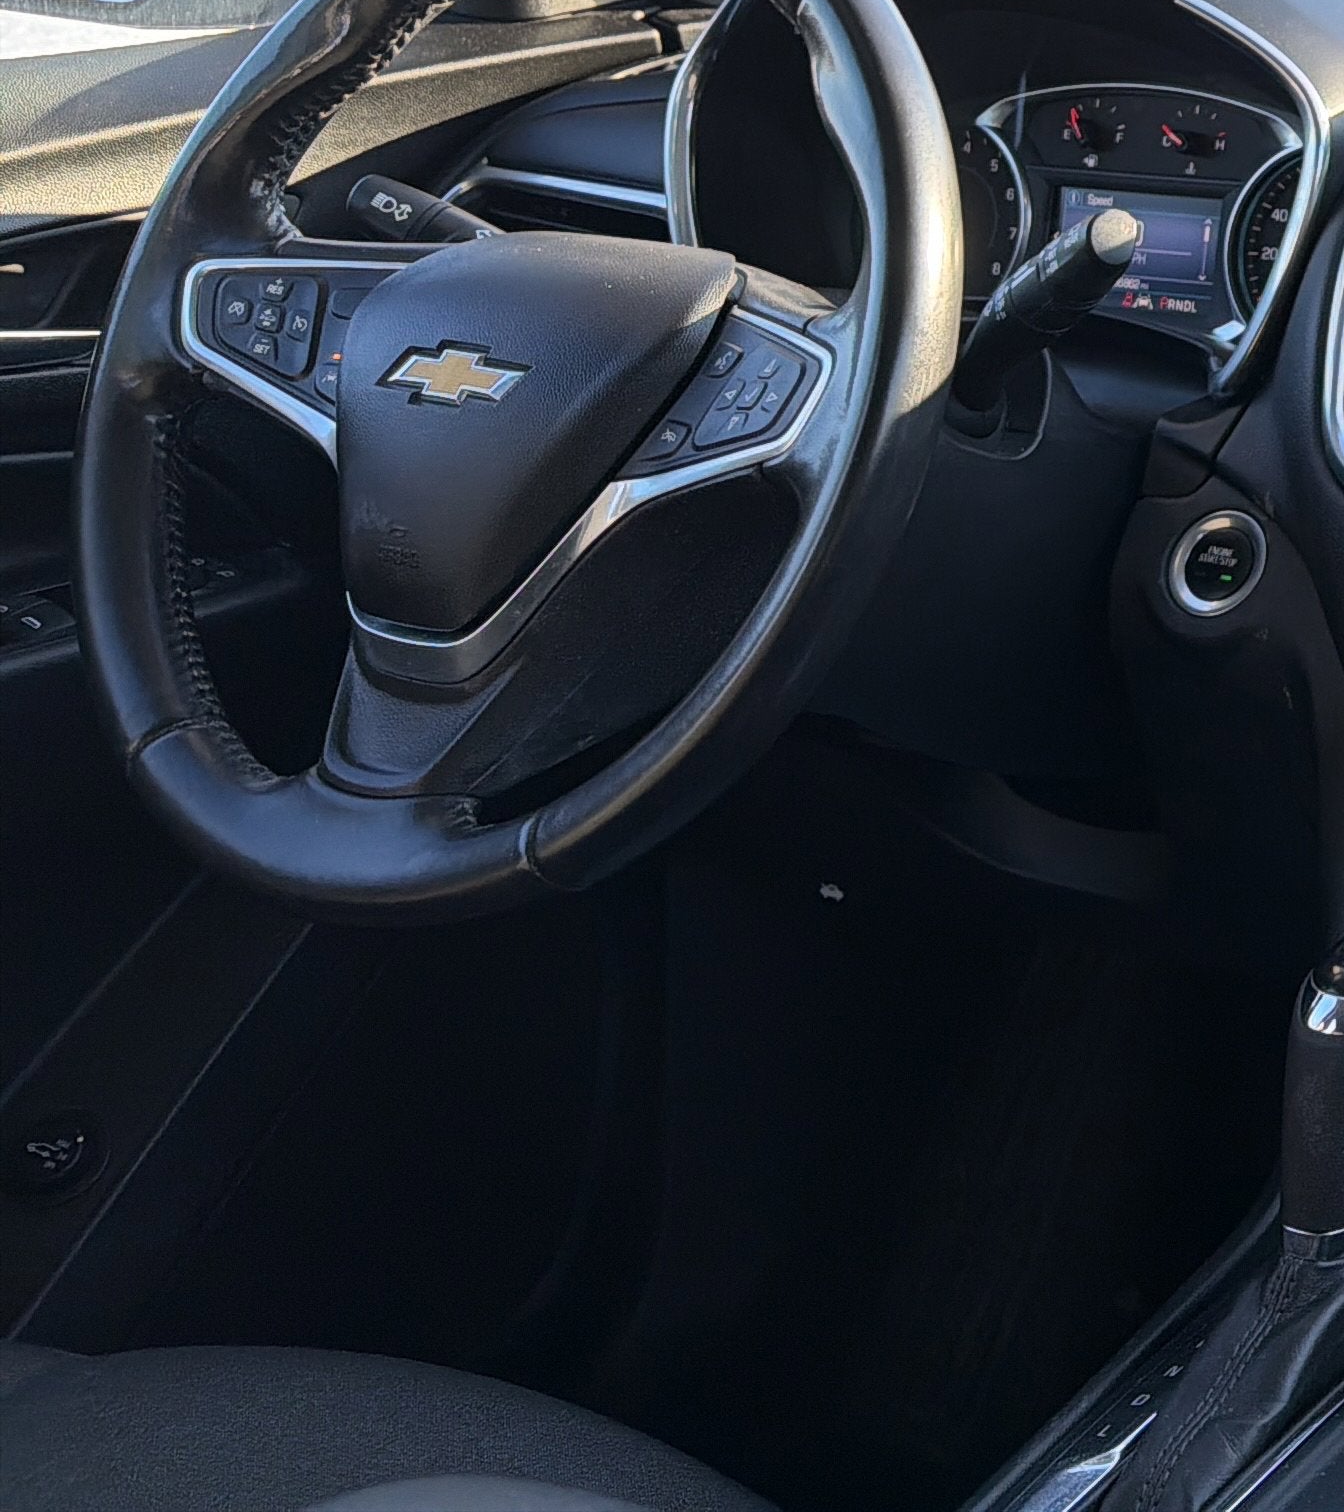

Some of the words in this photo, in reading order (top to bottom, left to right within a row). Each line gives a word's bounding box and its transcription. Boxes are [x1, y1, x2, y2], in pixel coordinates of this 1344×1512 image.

[1115, 131, 1125, 144] F
[962, 141, 972, 154] 4
[1214, 139, 1225, 151] H
[990, 159, 999, 173] 5
[1006, 188, 1015, 201] 6
[1087, 193, 1114, 207] Speed
[1271, 208, 1289, 223] 40
[1009, 227, 1018, 240] 7
[1132, 252, 1147, 265] PH
[1261, 246, 1279, 261] 20
[991, 261, 1001, 276] 8
[265, 283, 284, 296] RES
[253, 343, 270, 356] SET
[1163, 1365, 1184, 1377] N
[1130, 1393, 1152, 1406] D
[1097, 1424, 1112, 1438] L
